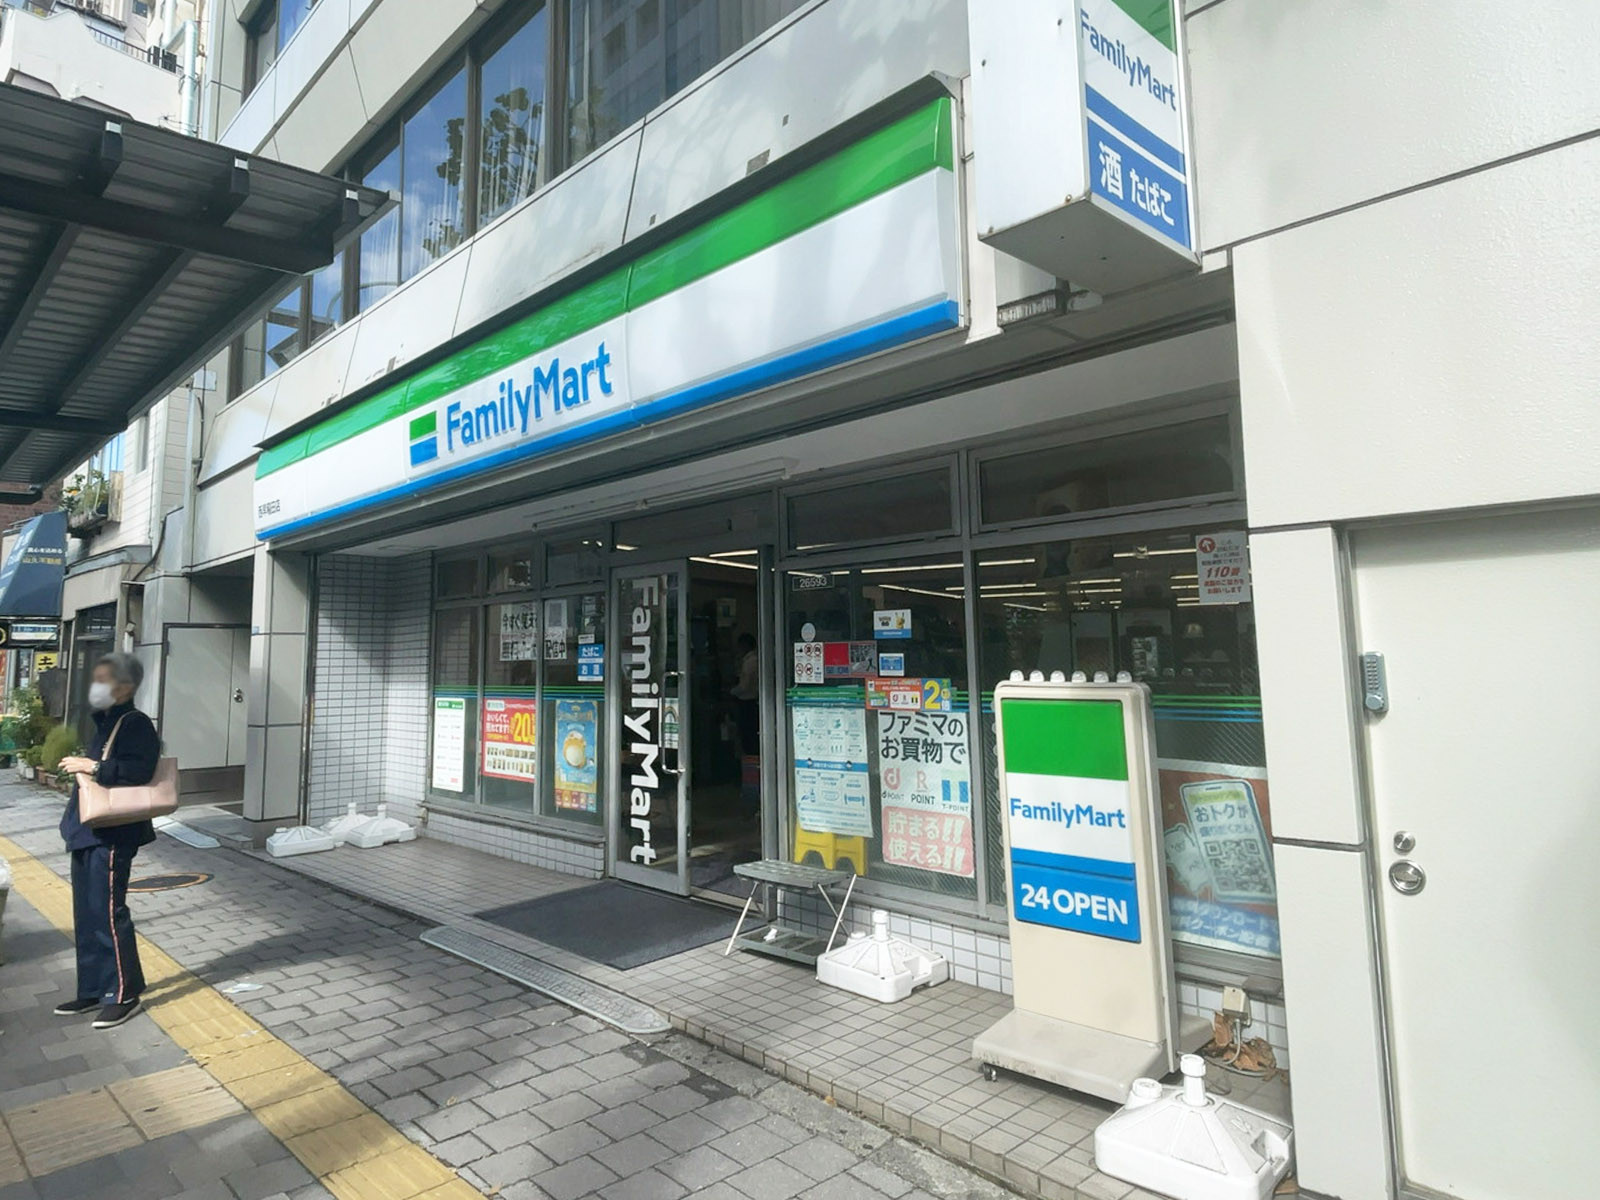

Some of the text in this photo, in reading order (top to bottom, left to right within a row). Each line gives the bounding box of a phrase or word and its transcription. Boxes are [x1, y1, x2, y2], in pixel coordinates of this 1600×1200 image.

[1080, 8, 1177, 111] FamilyMart
[1099, 141, 1175, 226] 酒 たばこ
[447, 342, 613, 452] FamilyMart
[582, 646, 600, 657] たばこ
[924, 680, 941, 710] 2
[623, 577, 659, 865] FamilyMart
[879, 711, 964, 737] ファミマの
[881, 736, 966, 764] お買物で
[911, 794, 935, 806] POINT
[1010, 797, 1126, 830] FamilyMart
